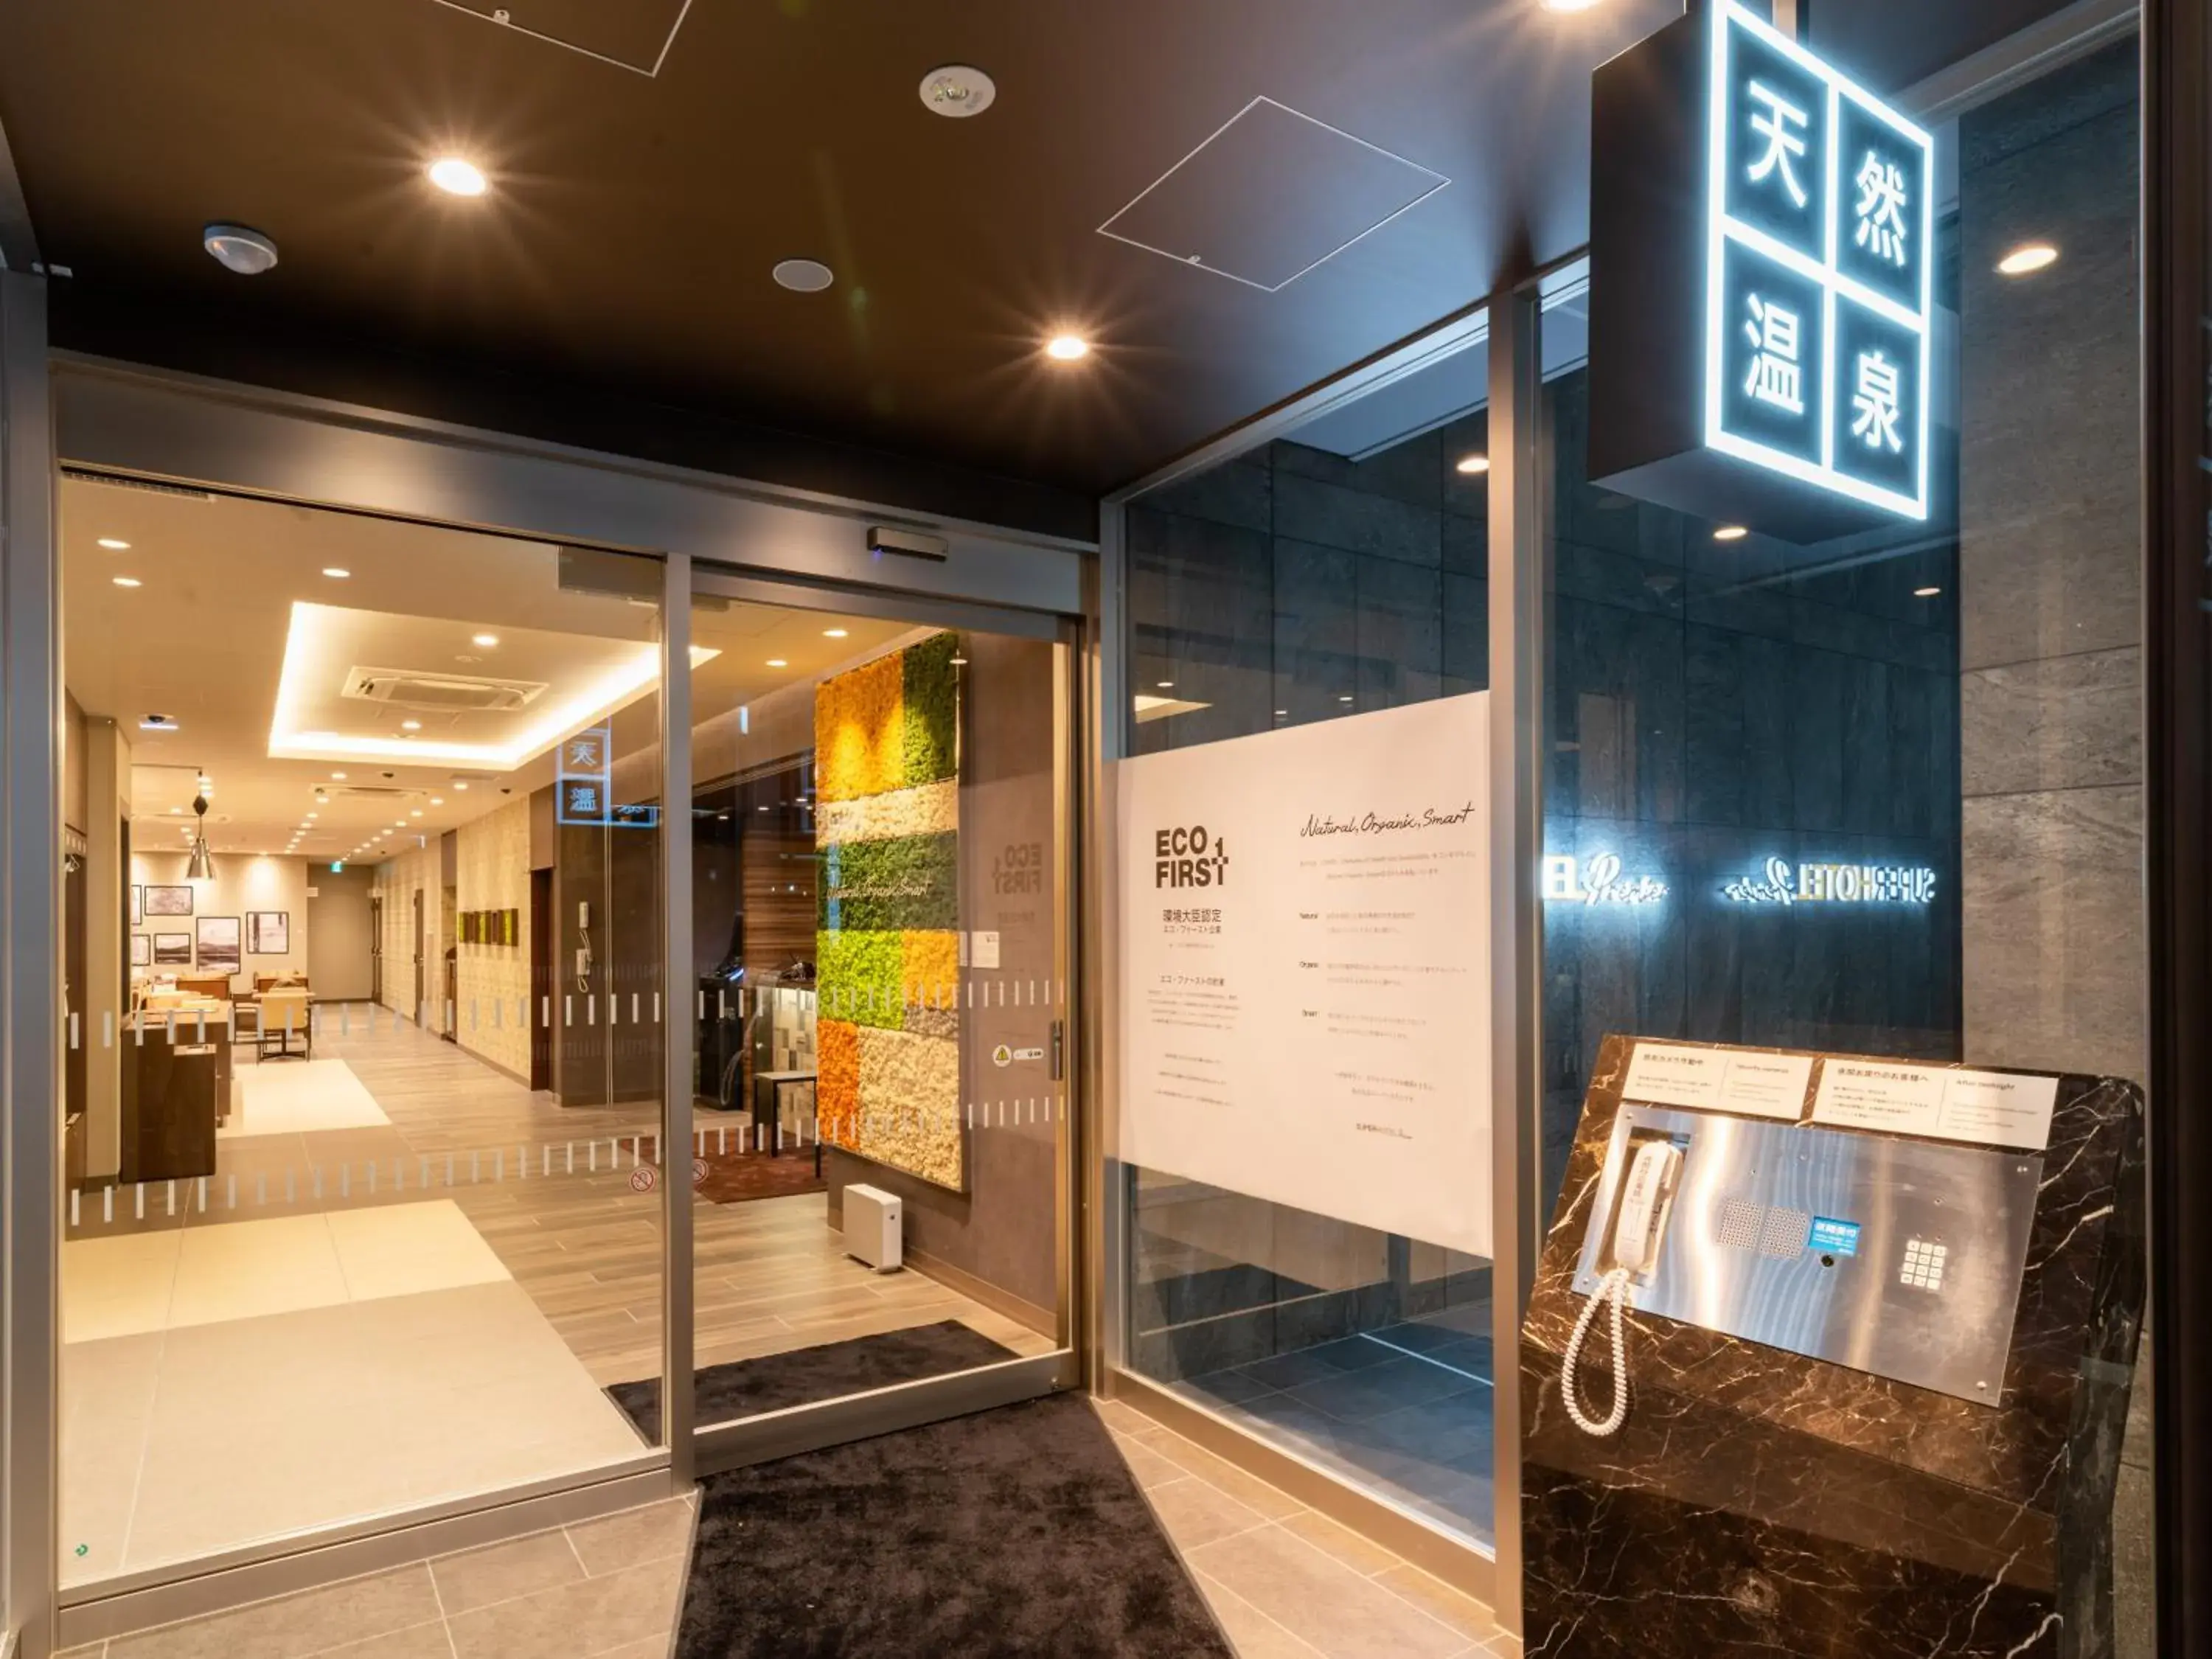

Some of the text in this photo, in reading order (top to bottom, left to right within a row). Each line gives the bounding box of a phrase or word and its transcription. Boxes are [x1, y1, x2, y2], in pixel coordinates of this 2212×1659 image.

[1423, 801, 1475, 827] Smart
[1155, 825, 1208, 858] ECO
[1155, 855, 1229, 888] FIRST
